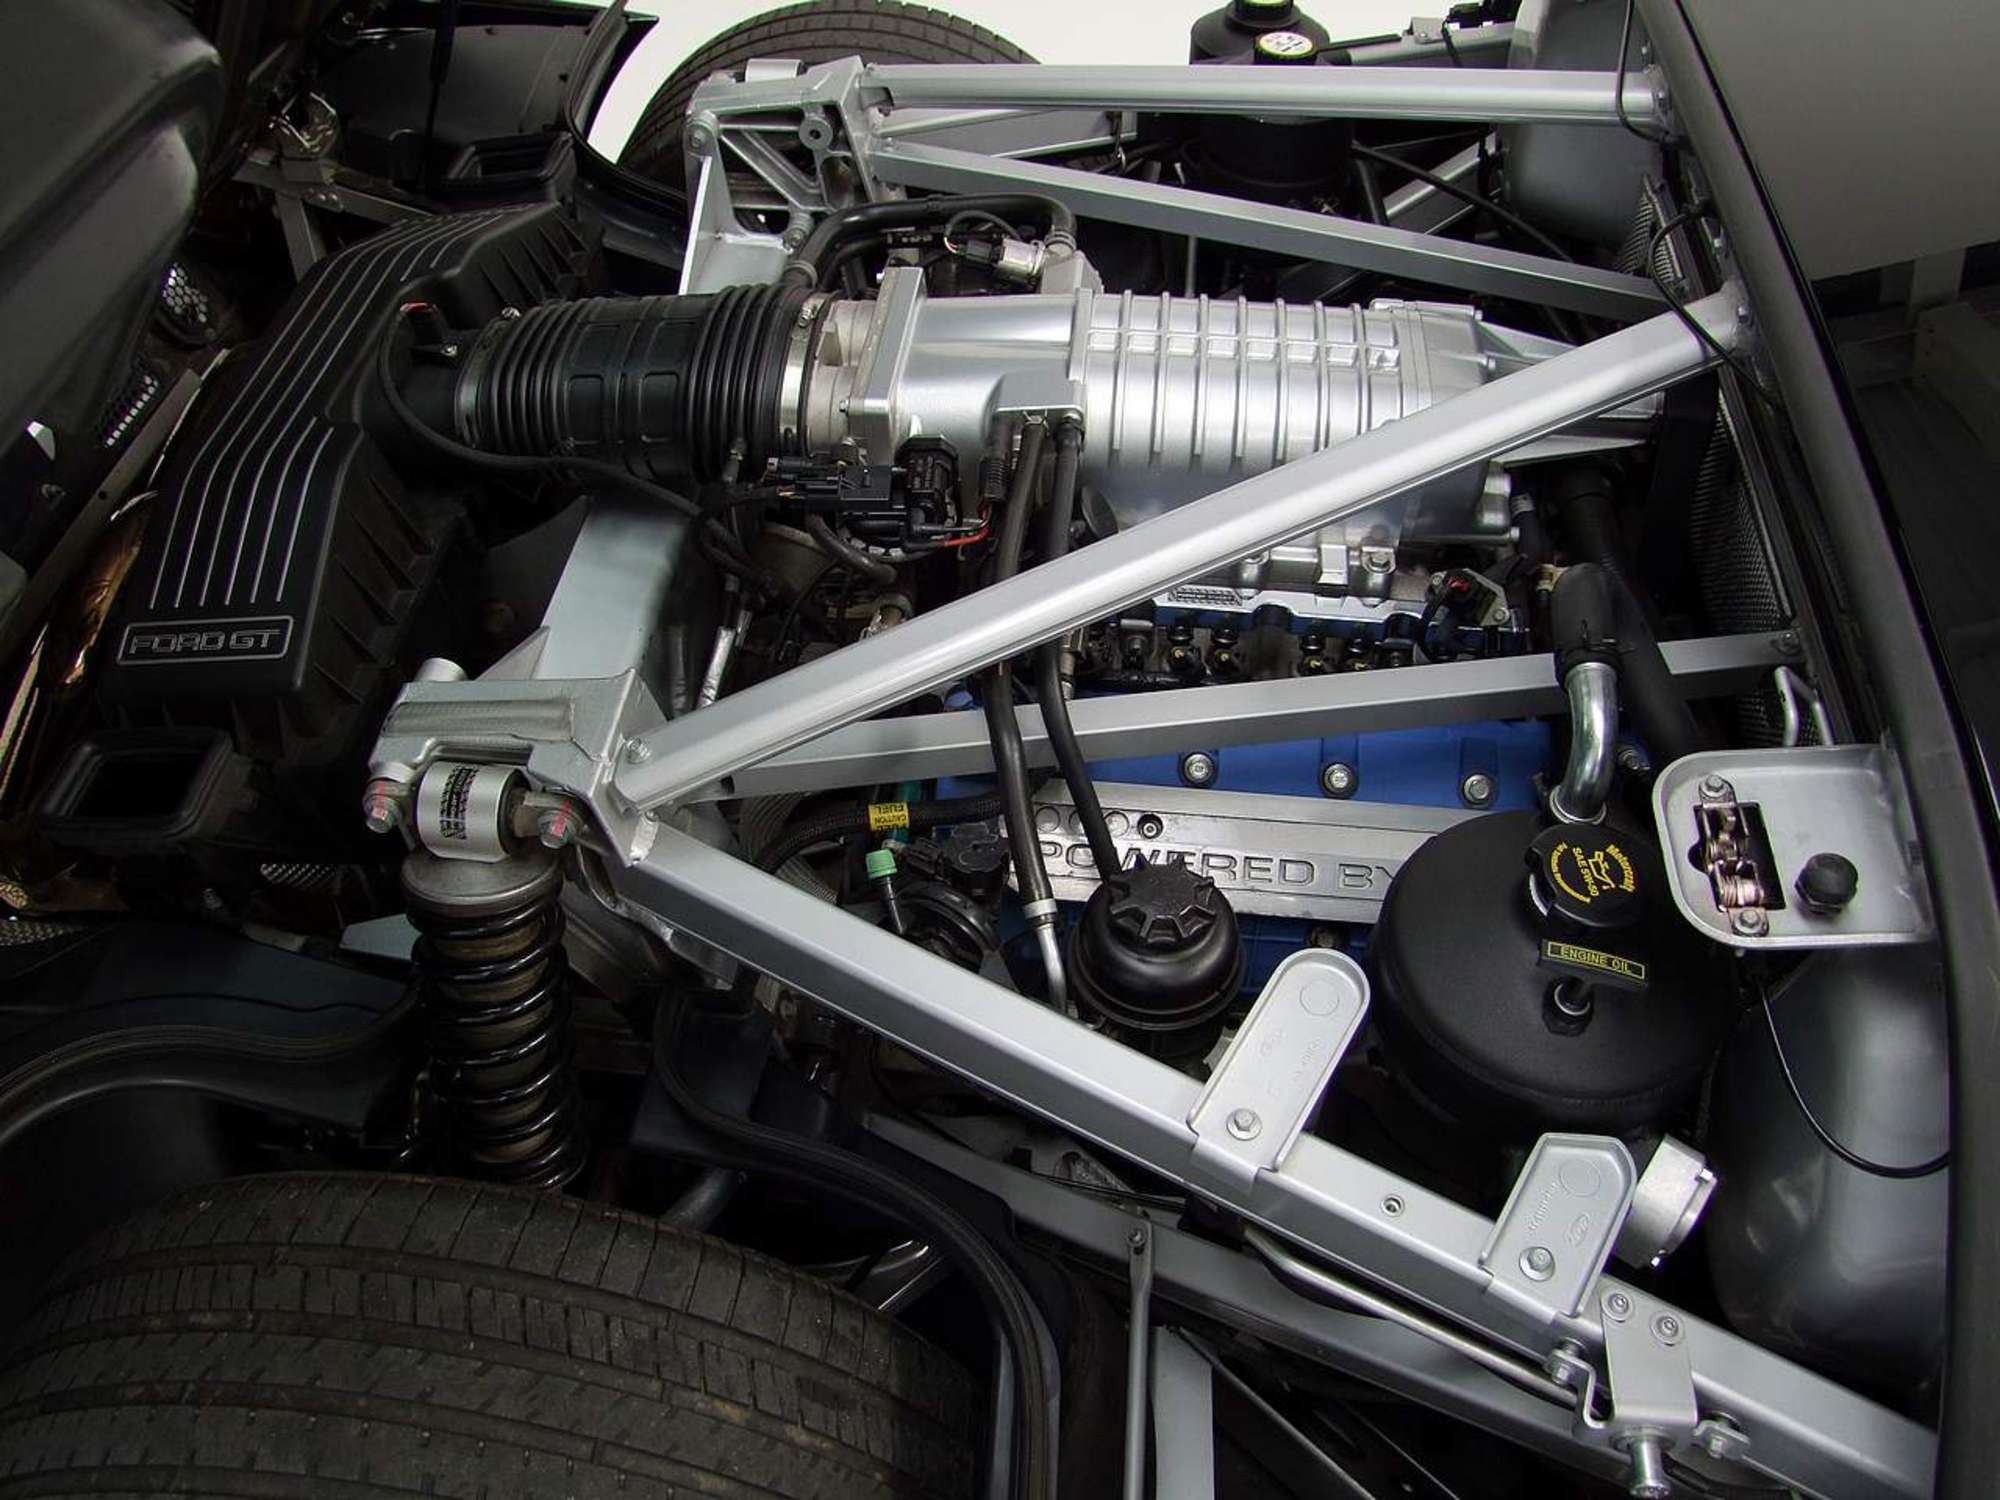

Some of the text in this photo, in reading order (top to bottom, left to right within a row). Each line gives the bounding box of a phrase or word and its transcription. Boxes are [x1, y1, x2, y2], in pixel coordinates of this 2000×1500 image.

[129, 629, 281, 654] FORD GT
[873, 804, 905, 814] FUEL
[1573, 847, 1588, 869] SAE
[1561, 946, 1632, 974] ENGINE OIL
